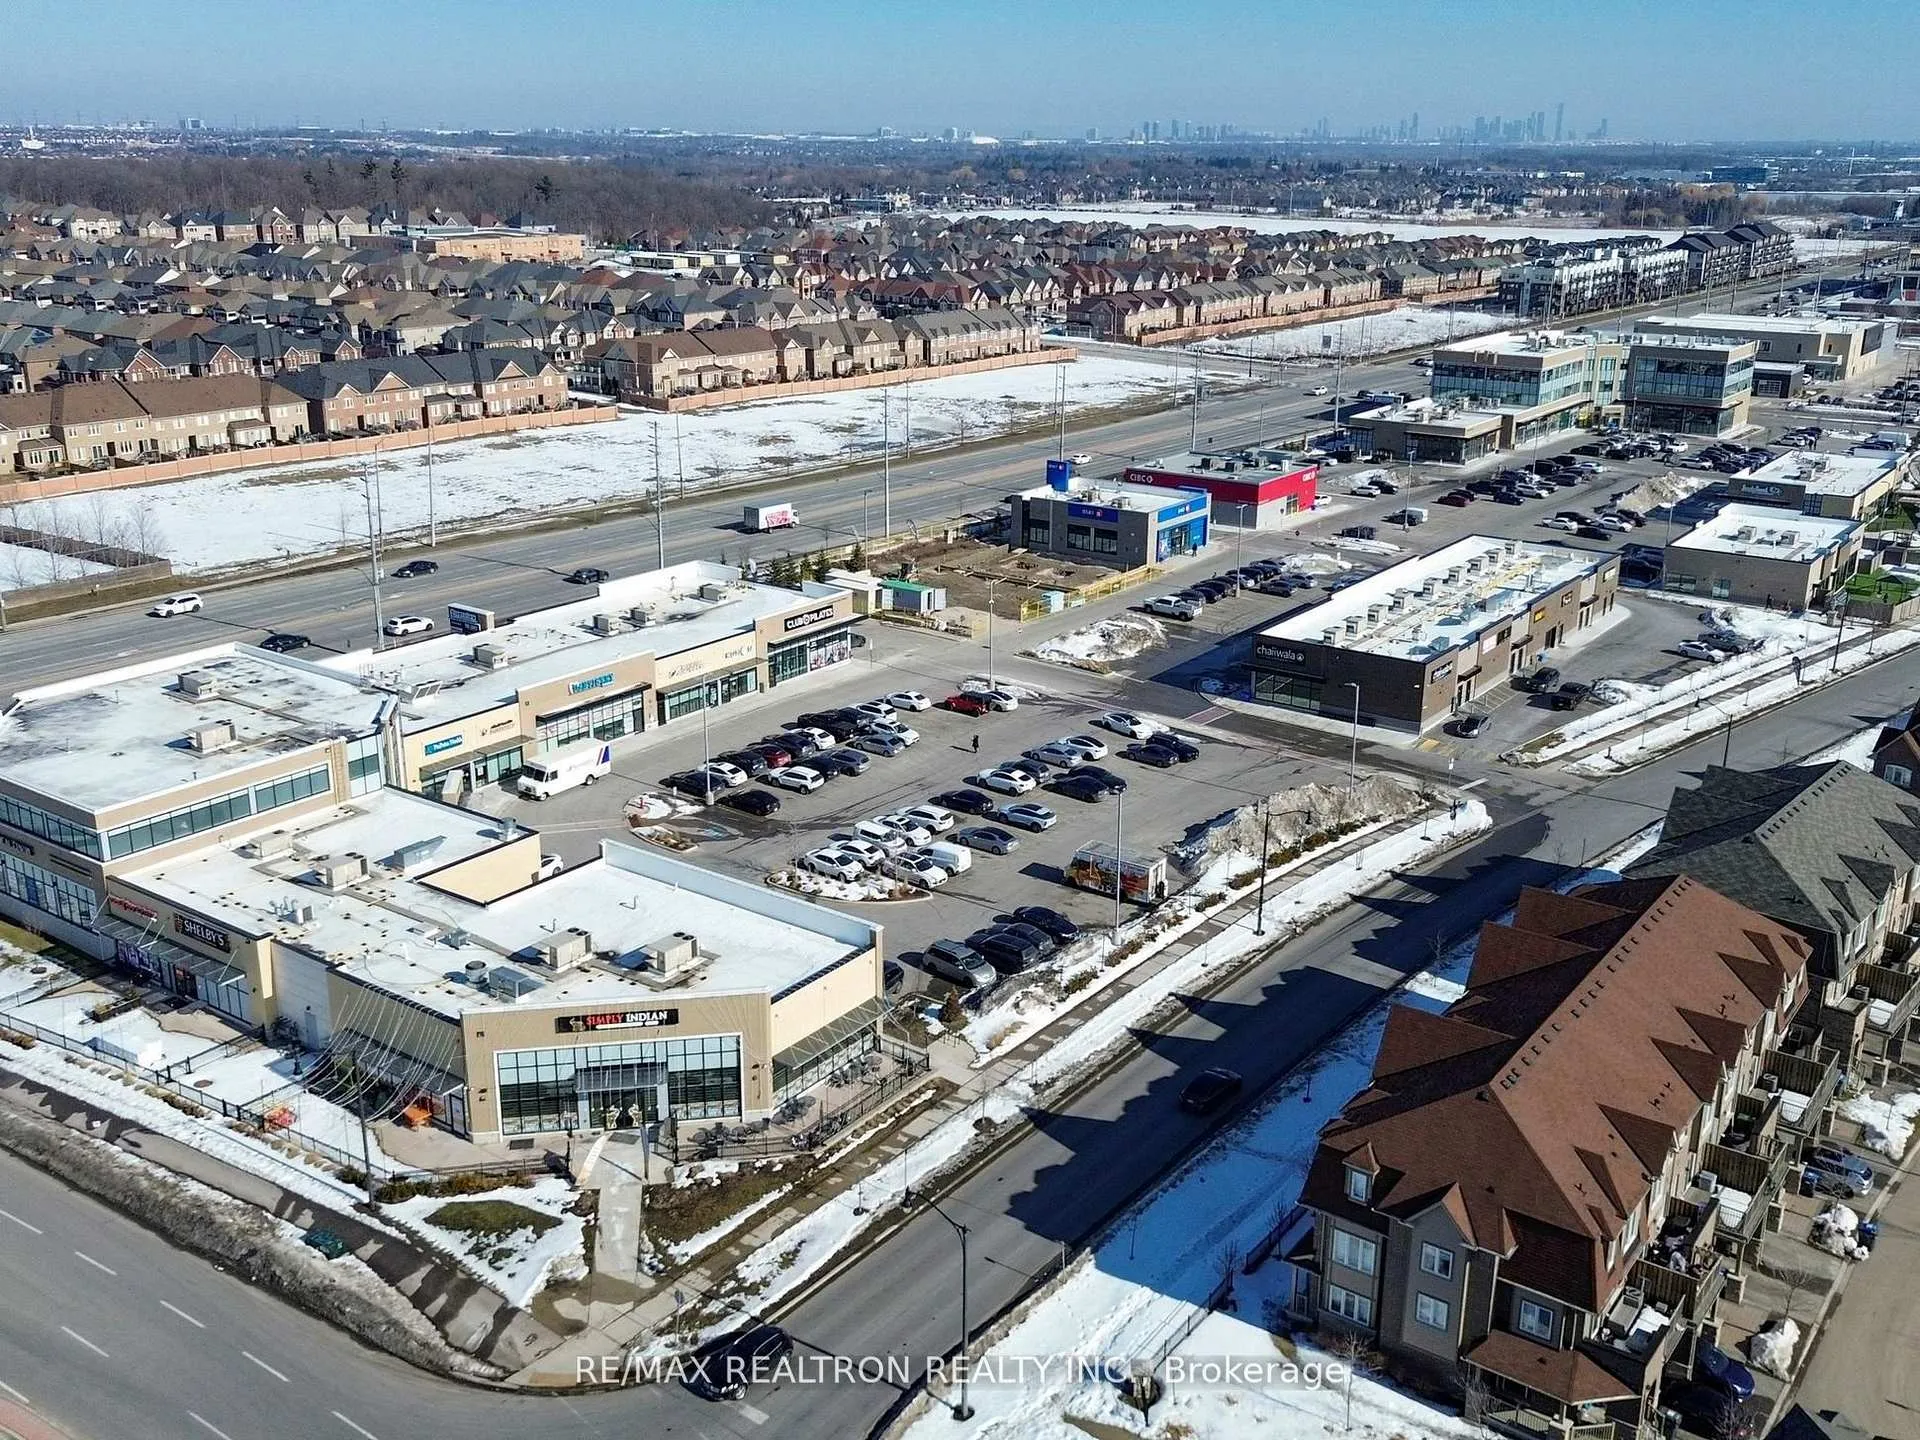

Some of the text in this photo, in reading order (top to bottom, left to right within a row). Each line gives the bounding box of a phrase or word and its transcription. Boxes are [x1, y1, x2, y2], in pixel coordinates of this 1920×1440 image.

[786, 608, 833, 629] CLUB PILATES
[1256, 645, 1295, 661] chaiiwala
[184, 920, 224, 947] SHELBY'S
[585, 1011, 668, 1026] SIMPLY INDIAN
